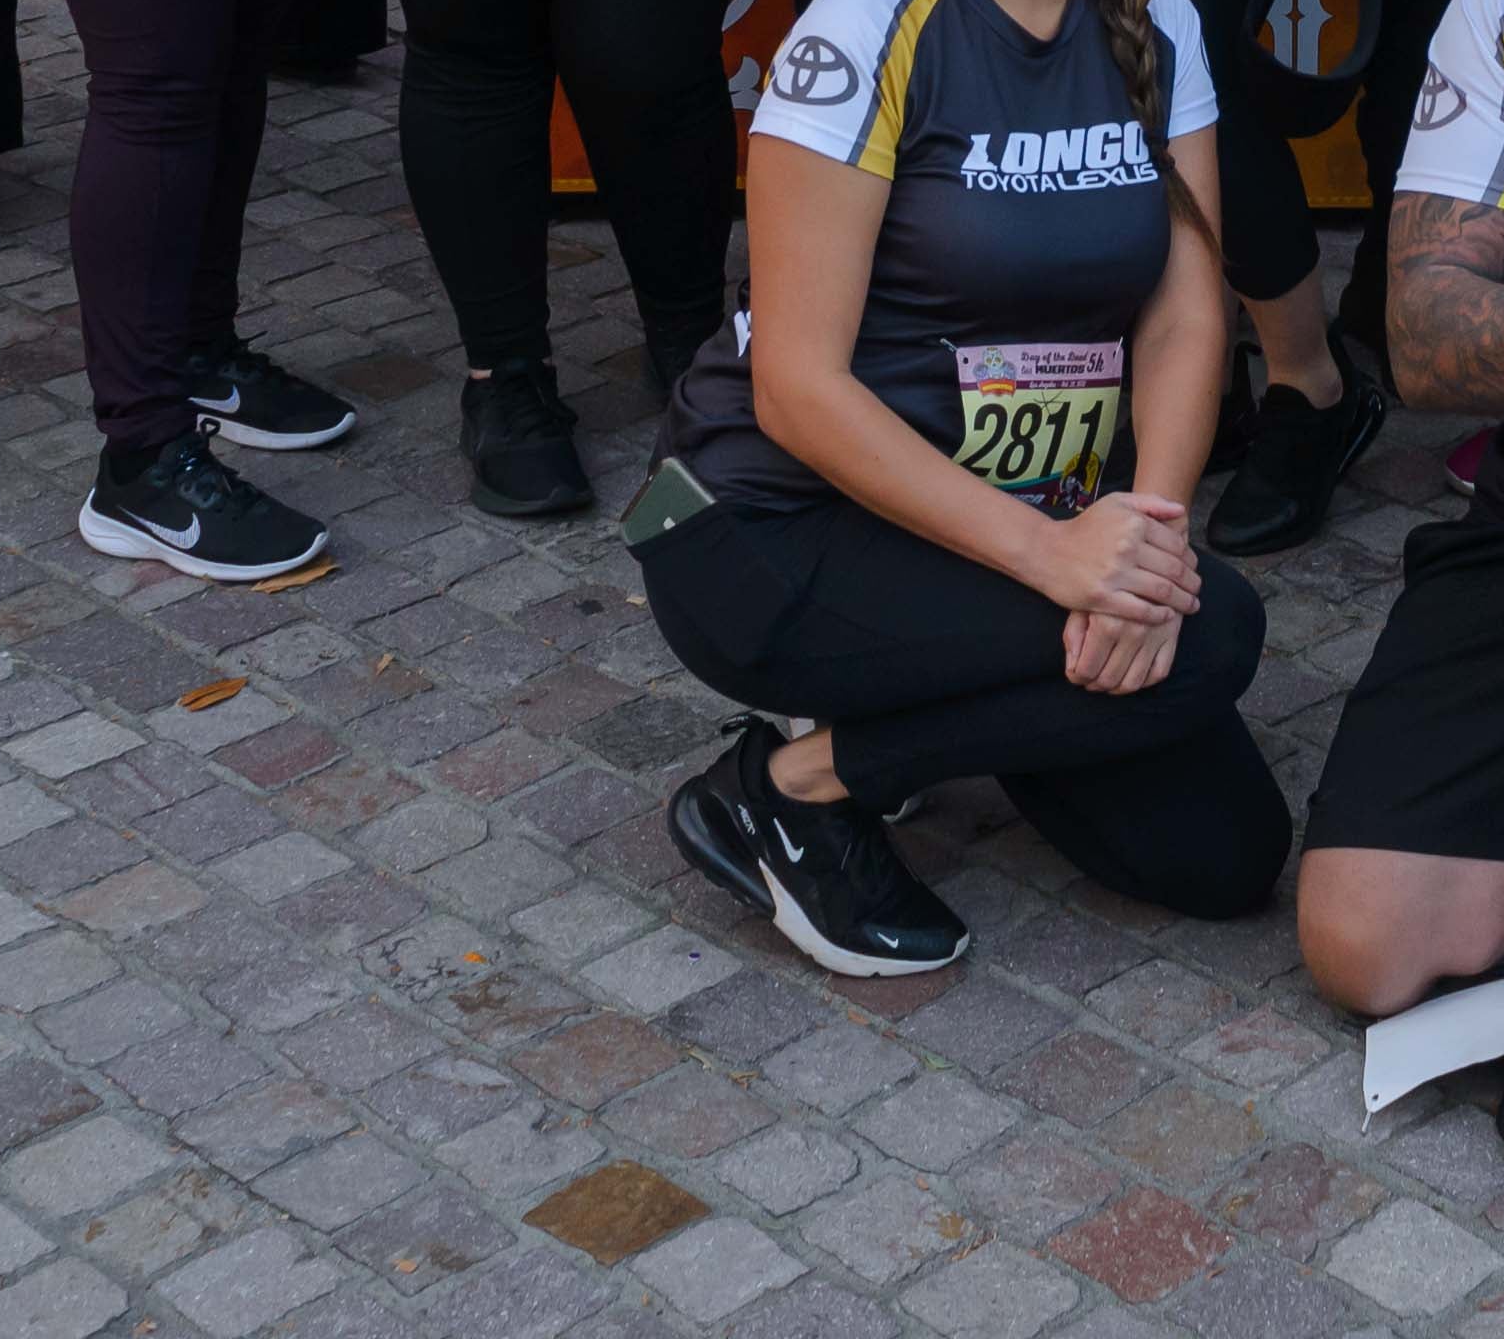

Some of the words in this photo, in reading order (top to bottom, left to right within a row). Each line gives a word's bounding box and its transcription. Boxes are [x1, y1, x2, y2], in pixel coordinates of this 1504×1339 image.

[960, 120, 1150, 174] LONGO
[960, 170, 1057, 193] TOYOTA
[1056, 162, 1159, 191] LEXUS
[1020, 352, 1040, 364] Day
[1067, 351, 1088, 361] Dead
[1035, 364, 1085, 375] MUERTOS
[1087, 353, 1104, 373] 5k
[960, 400, 1104, 480] 2811
